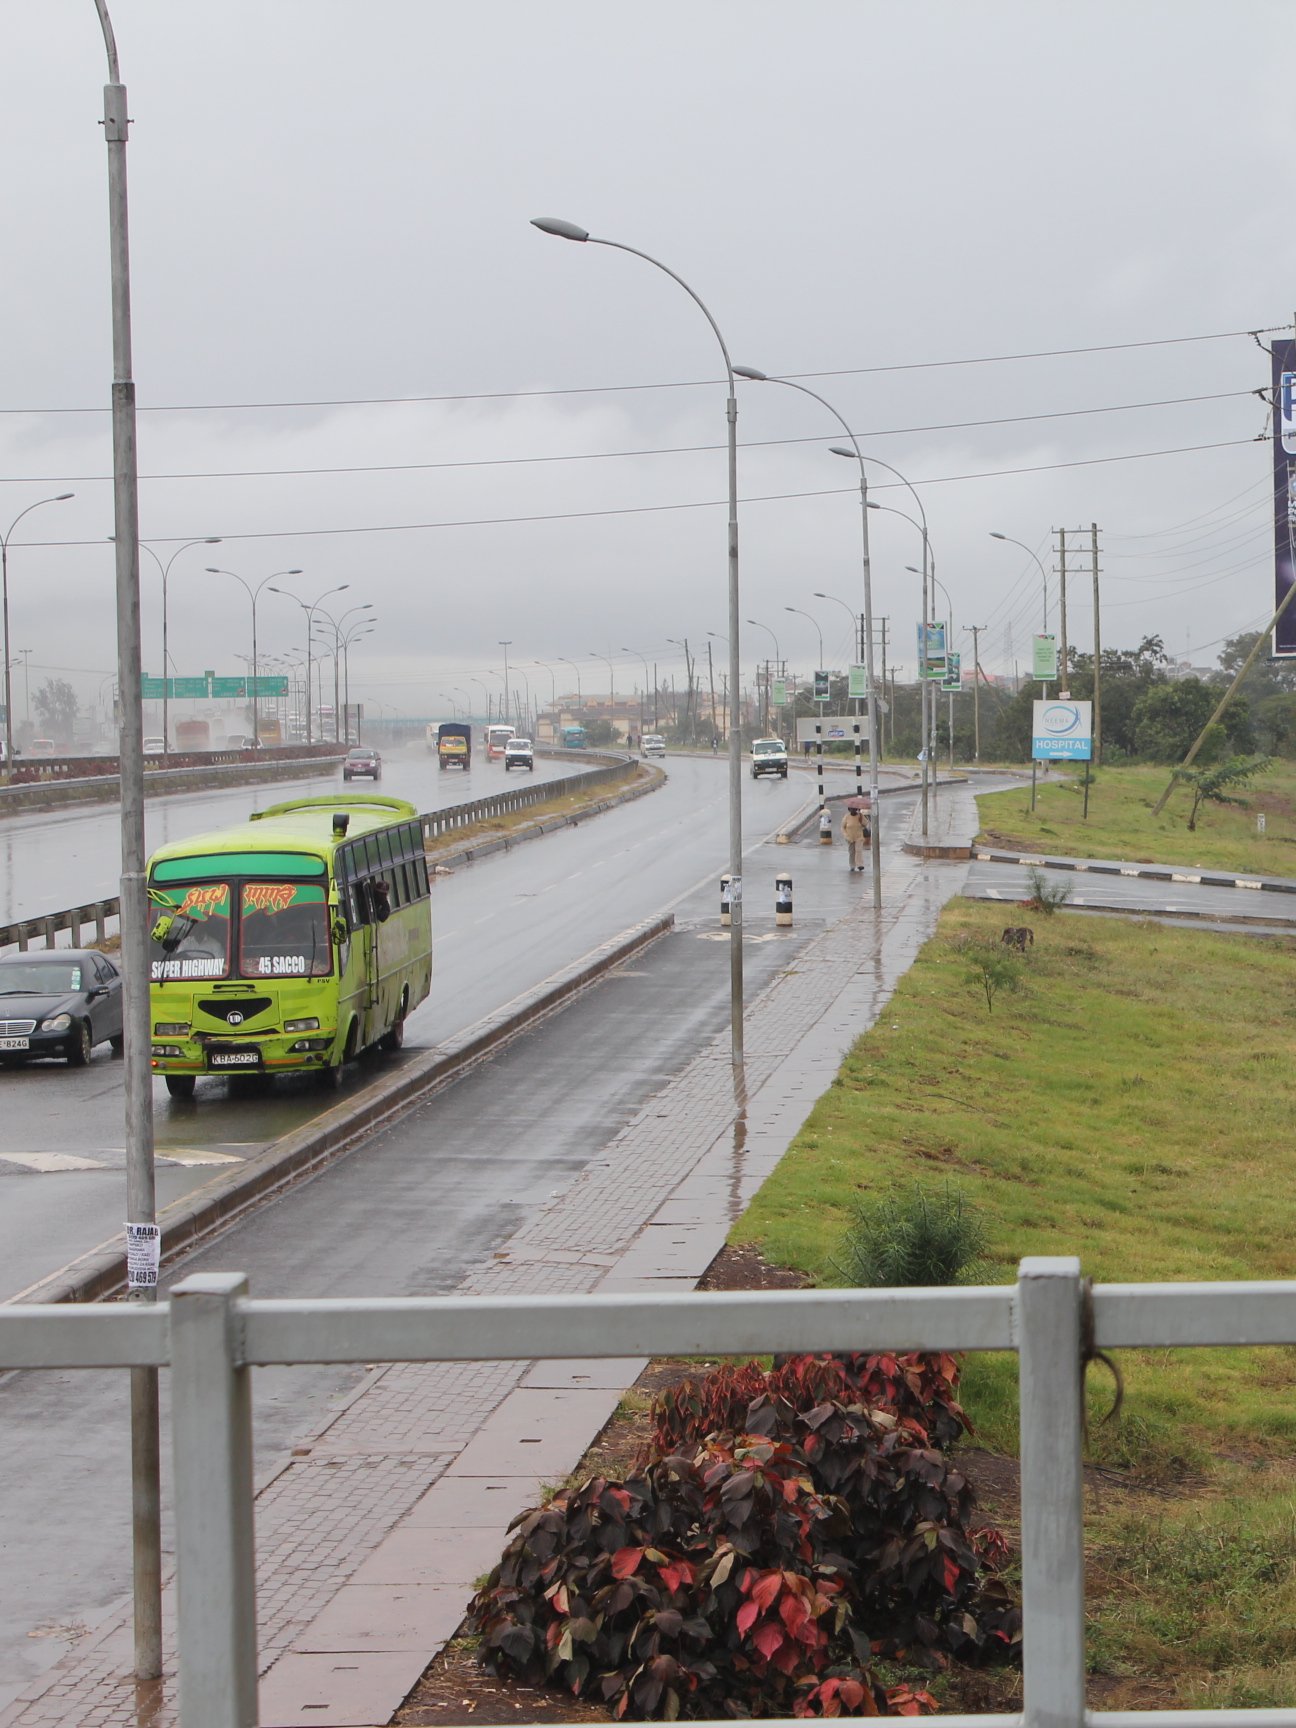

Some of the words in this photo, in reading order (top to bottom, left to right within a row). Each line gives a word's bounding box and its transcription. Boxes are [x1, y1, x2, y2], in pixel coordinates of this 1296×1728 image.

[1036, 740, 1088, 749] HOSPITAL
[151, 960, 180, 979] SUPER
[182, 958, 225, 977] HIGHWAY
[258, 957, 272, 974] 45
[273, 955, 305, 974] SACCO
